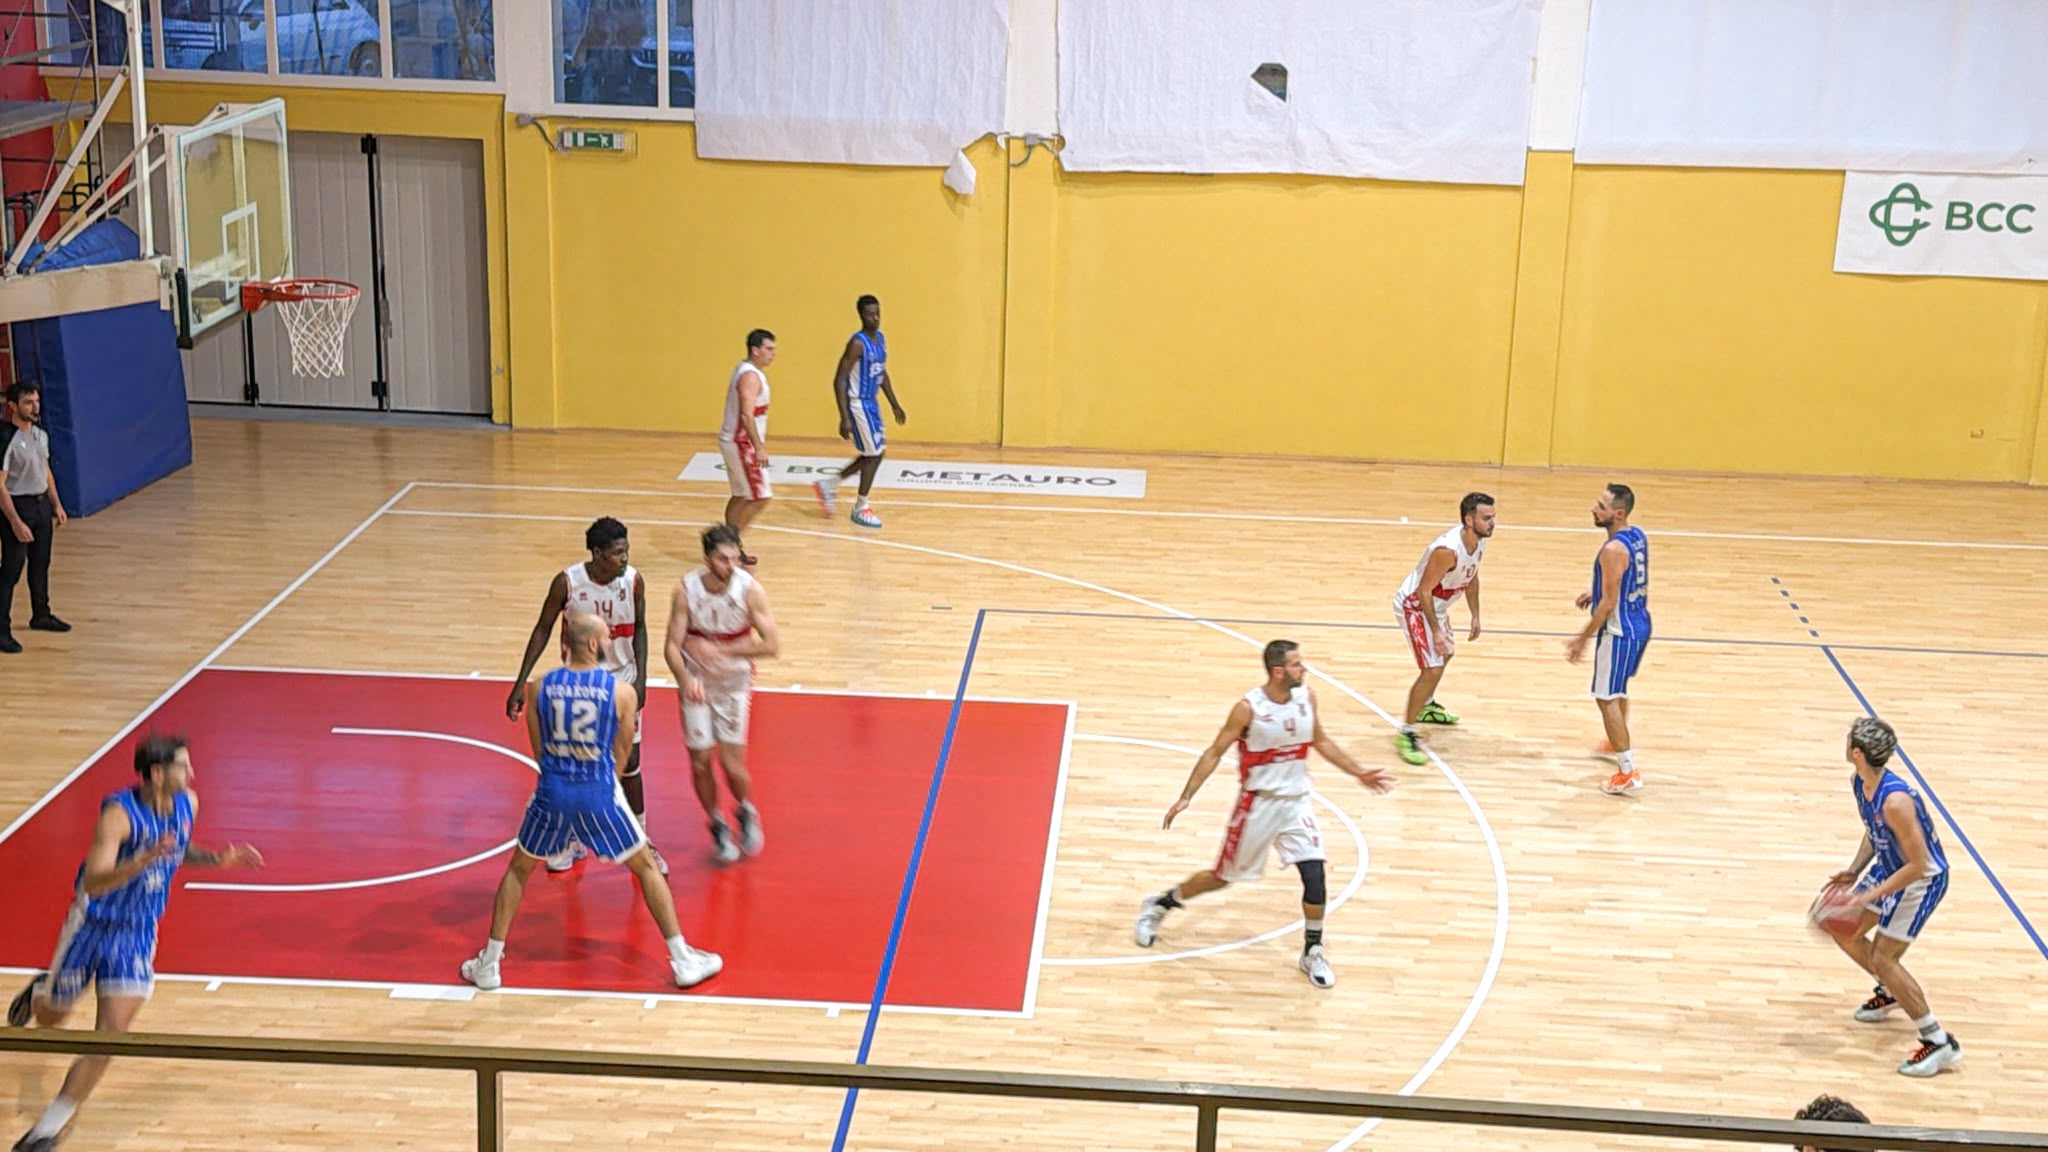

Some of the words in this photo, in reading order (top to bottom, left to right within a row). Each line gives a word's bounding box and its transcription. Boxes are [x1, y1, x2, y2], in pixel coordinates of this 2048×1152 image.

[1945, 201, 2036, 234] BCC
[899, 469, 1117, 487] METAURO
[594, 600, 613, 619] 14
[551, 698, 598, 743] 12
[1283, 718, 1297, 737] 4
